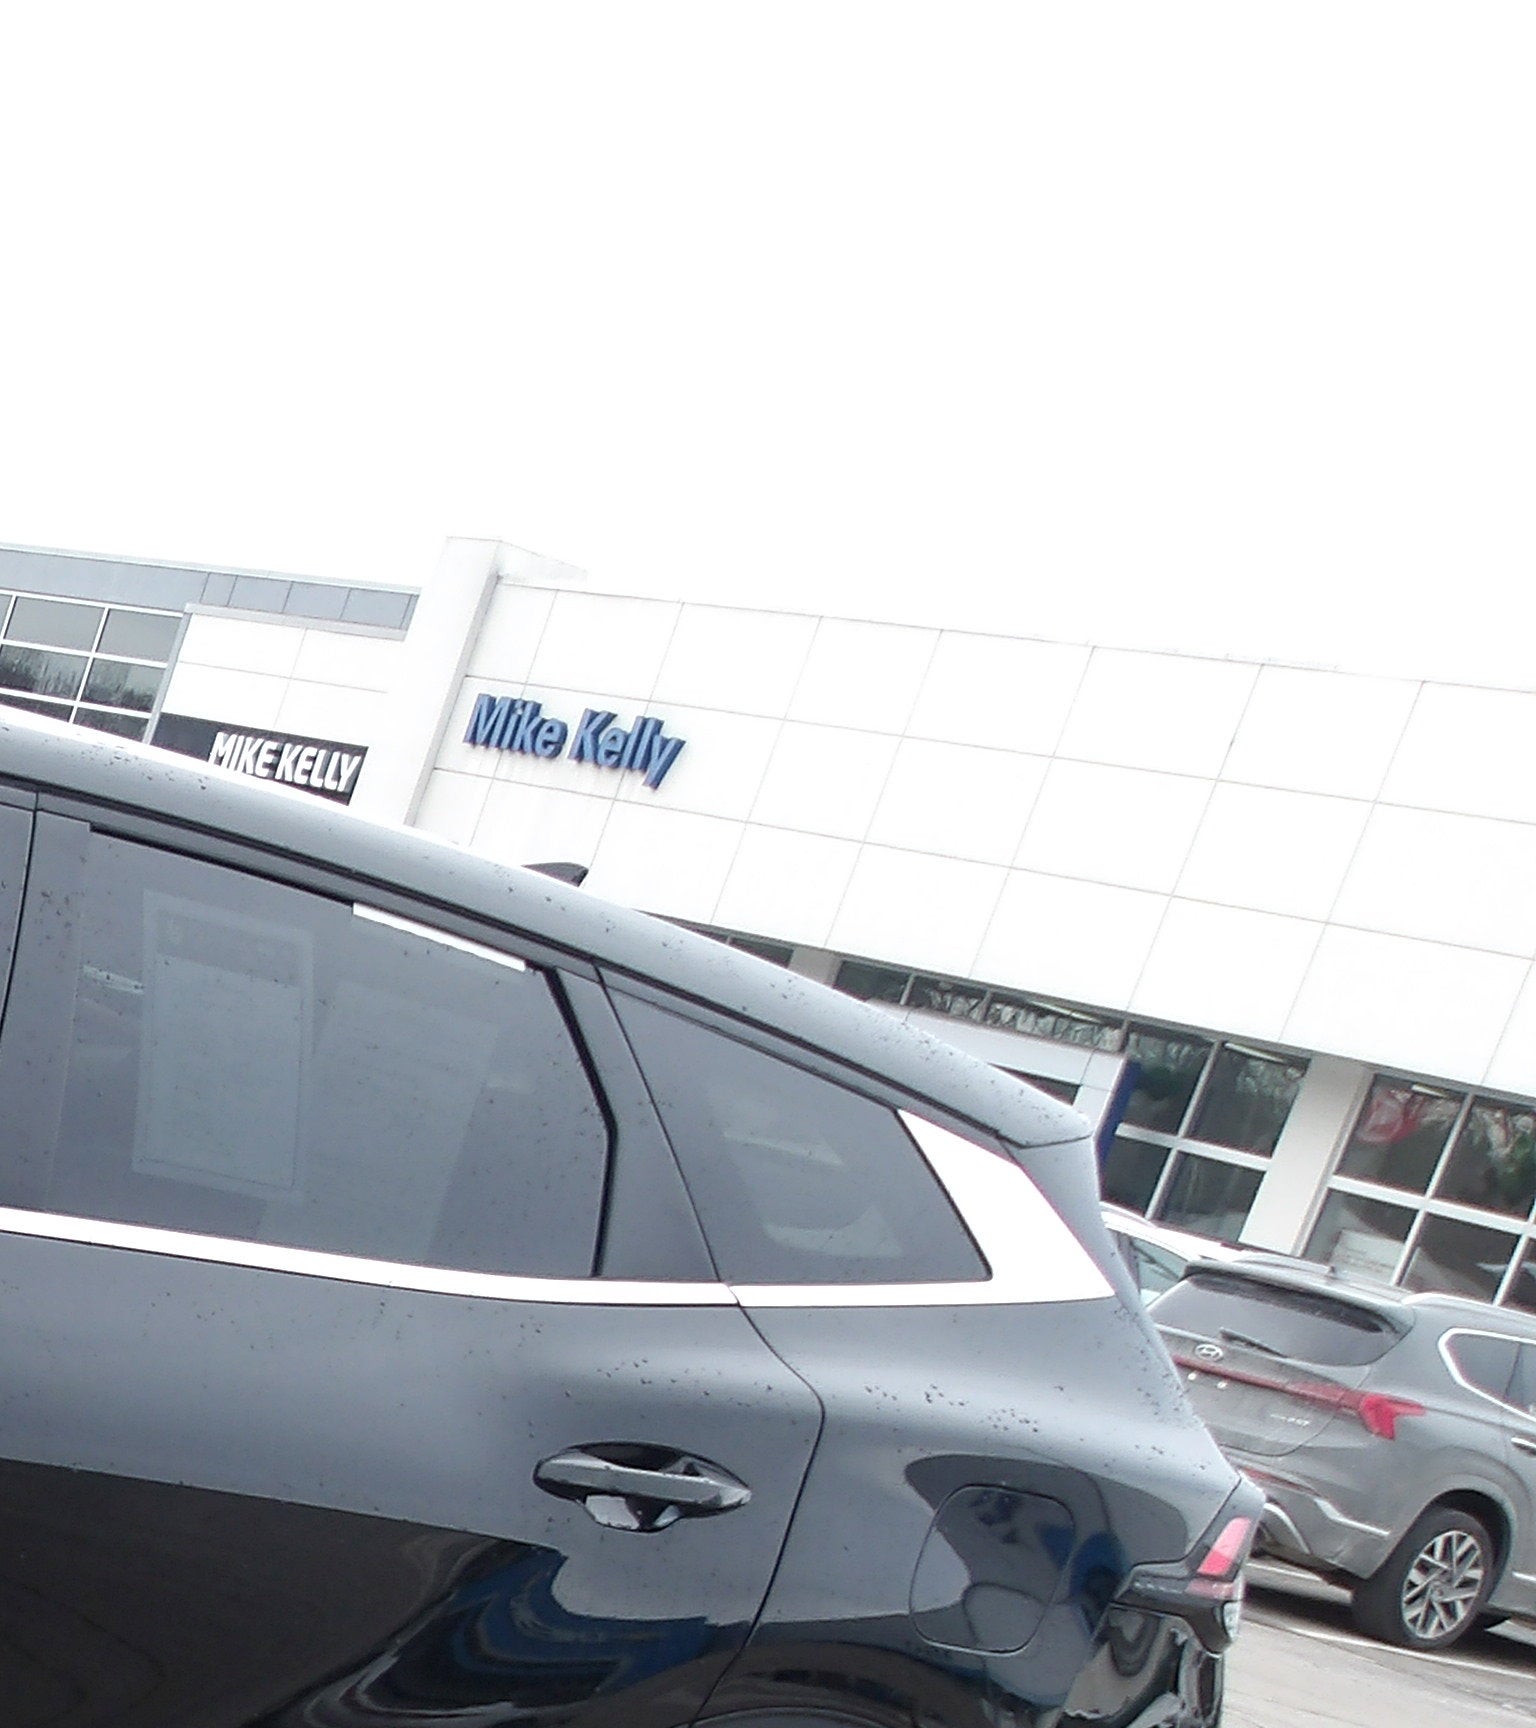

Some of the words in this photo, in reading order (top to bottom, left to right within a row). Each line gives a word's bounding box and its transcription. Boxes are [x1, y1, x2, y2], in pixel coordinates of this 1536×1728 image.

[208, 730, 278, 778] MIKE
[274, 742, 362, 793] KELLY
[463, 692, 569, 760] Mike
[567, 707, 687, 791] Kelly
